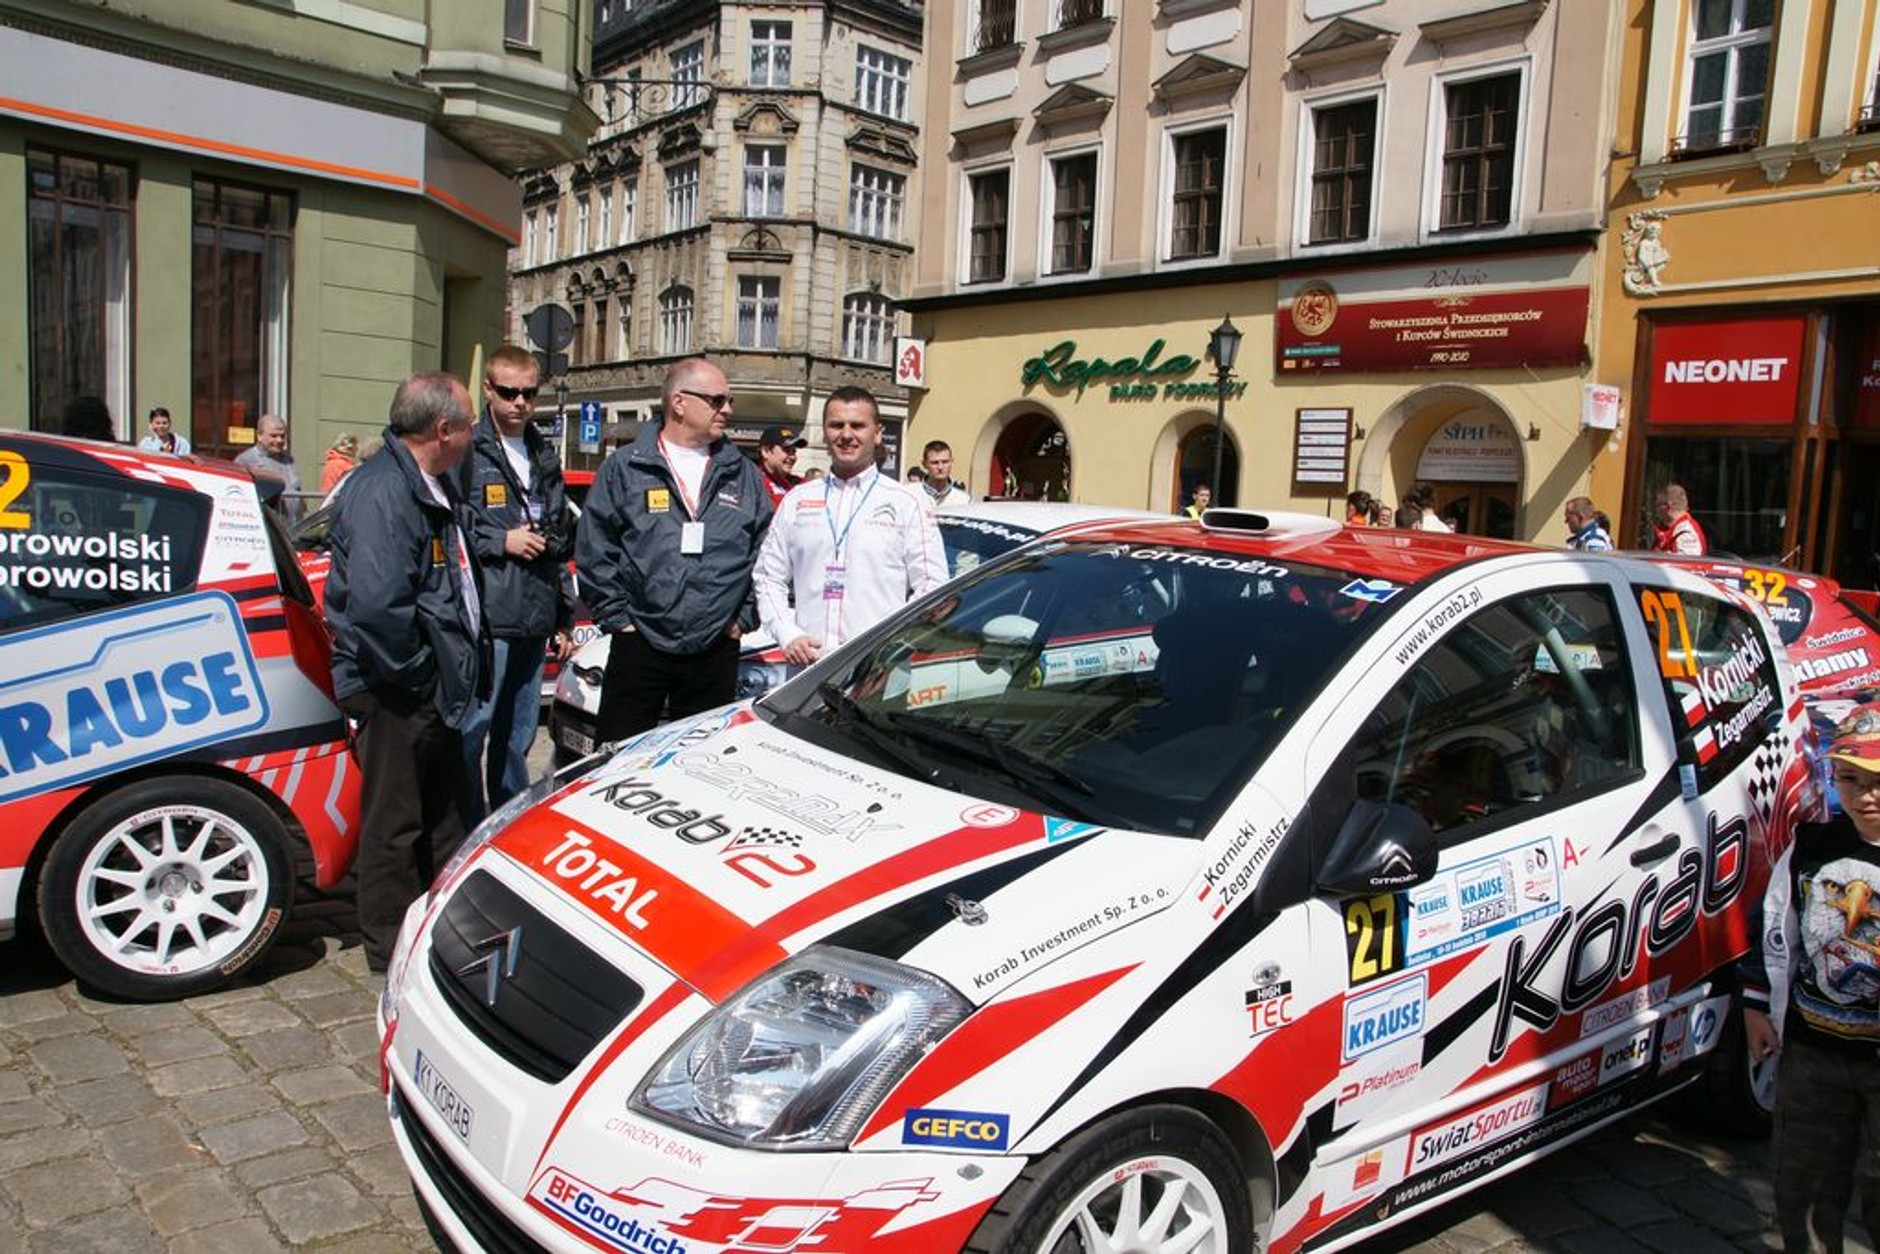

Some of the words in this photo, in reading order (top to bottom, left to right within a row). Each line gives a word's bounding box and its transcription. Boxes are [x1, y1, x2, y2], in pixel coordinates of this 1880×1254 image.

[1664, 357, 1788, 383] NEONET
[585, 424, 597, 441] P
[1743, 568, 1788, 605] 32
[1394, 585, 1484, 665] www.korab2.pl
[1640, 589, 1699, 679] 27
[1696, 626, 1766, 712] Kornicki
[0, 651, 251, 778] RAUSE
[1714, 683, 1774, 750] Zegarmistrz
[589, 776, 732, 846] Korab
[543, 829, 662, 932] TOTAL
[1203, 820, 1258, 888] Kornicki
[1218, 816, 1291, 907] Zegarmistrz
[1416, 893, 1449, 916] KRAUSE
[1461, 875, 1504, 906] KRAUSE
[973, 956, 1019, 990] Korab
[1020, 913, 1101, 963] Investment
[1103, 905, 1127, 922] Sp.
[1346, 891, 1396, 980] 27
[1487, 808, 1750, 1063] Korab
[1246, 995, 1293, 1033] TEC
[1257, 984, 1282, 1001] HIGH
[1349, 998, 1421, 1051] KRAUSE
[1360, 1061, 1419, 1096] Platinum
[1556, 1056, 1593, 1082] auto
[433, 1077, 470, 1138] KORAB
[911, 1116, 1001, 1142] GEFCO
[663, 1140, 709, 1168] BANK
[546, 1175, 687, 1254] BFGoodrich
